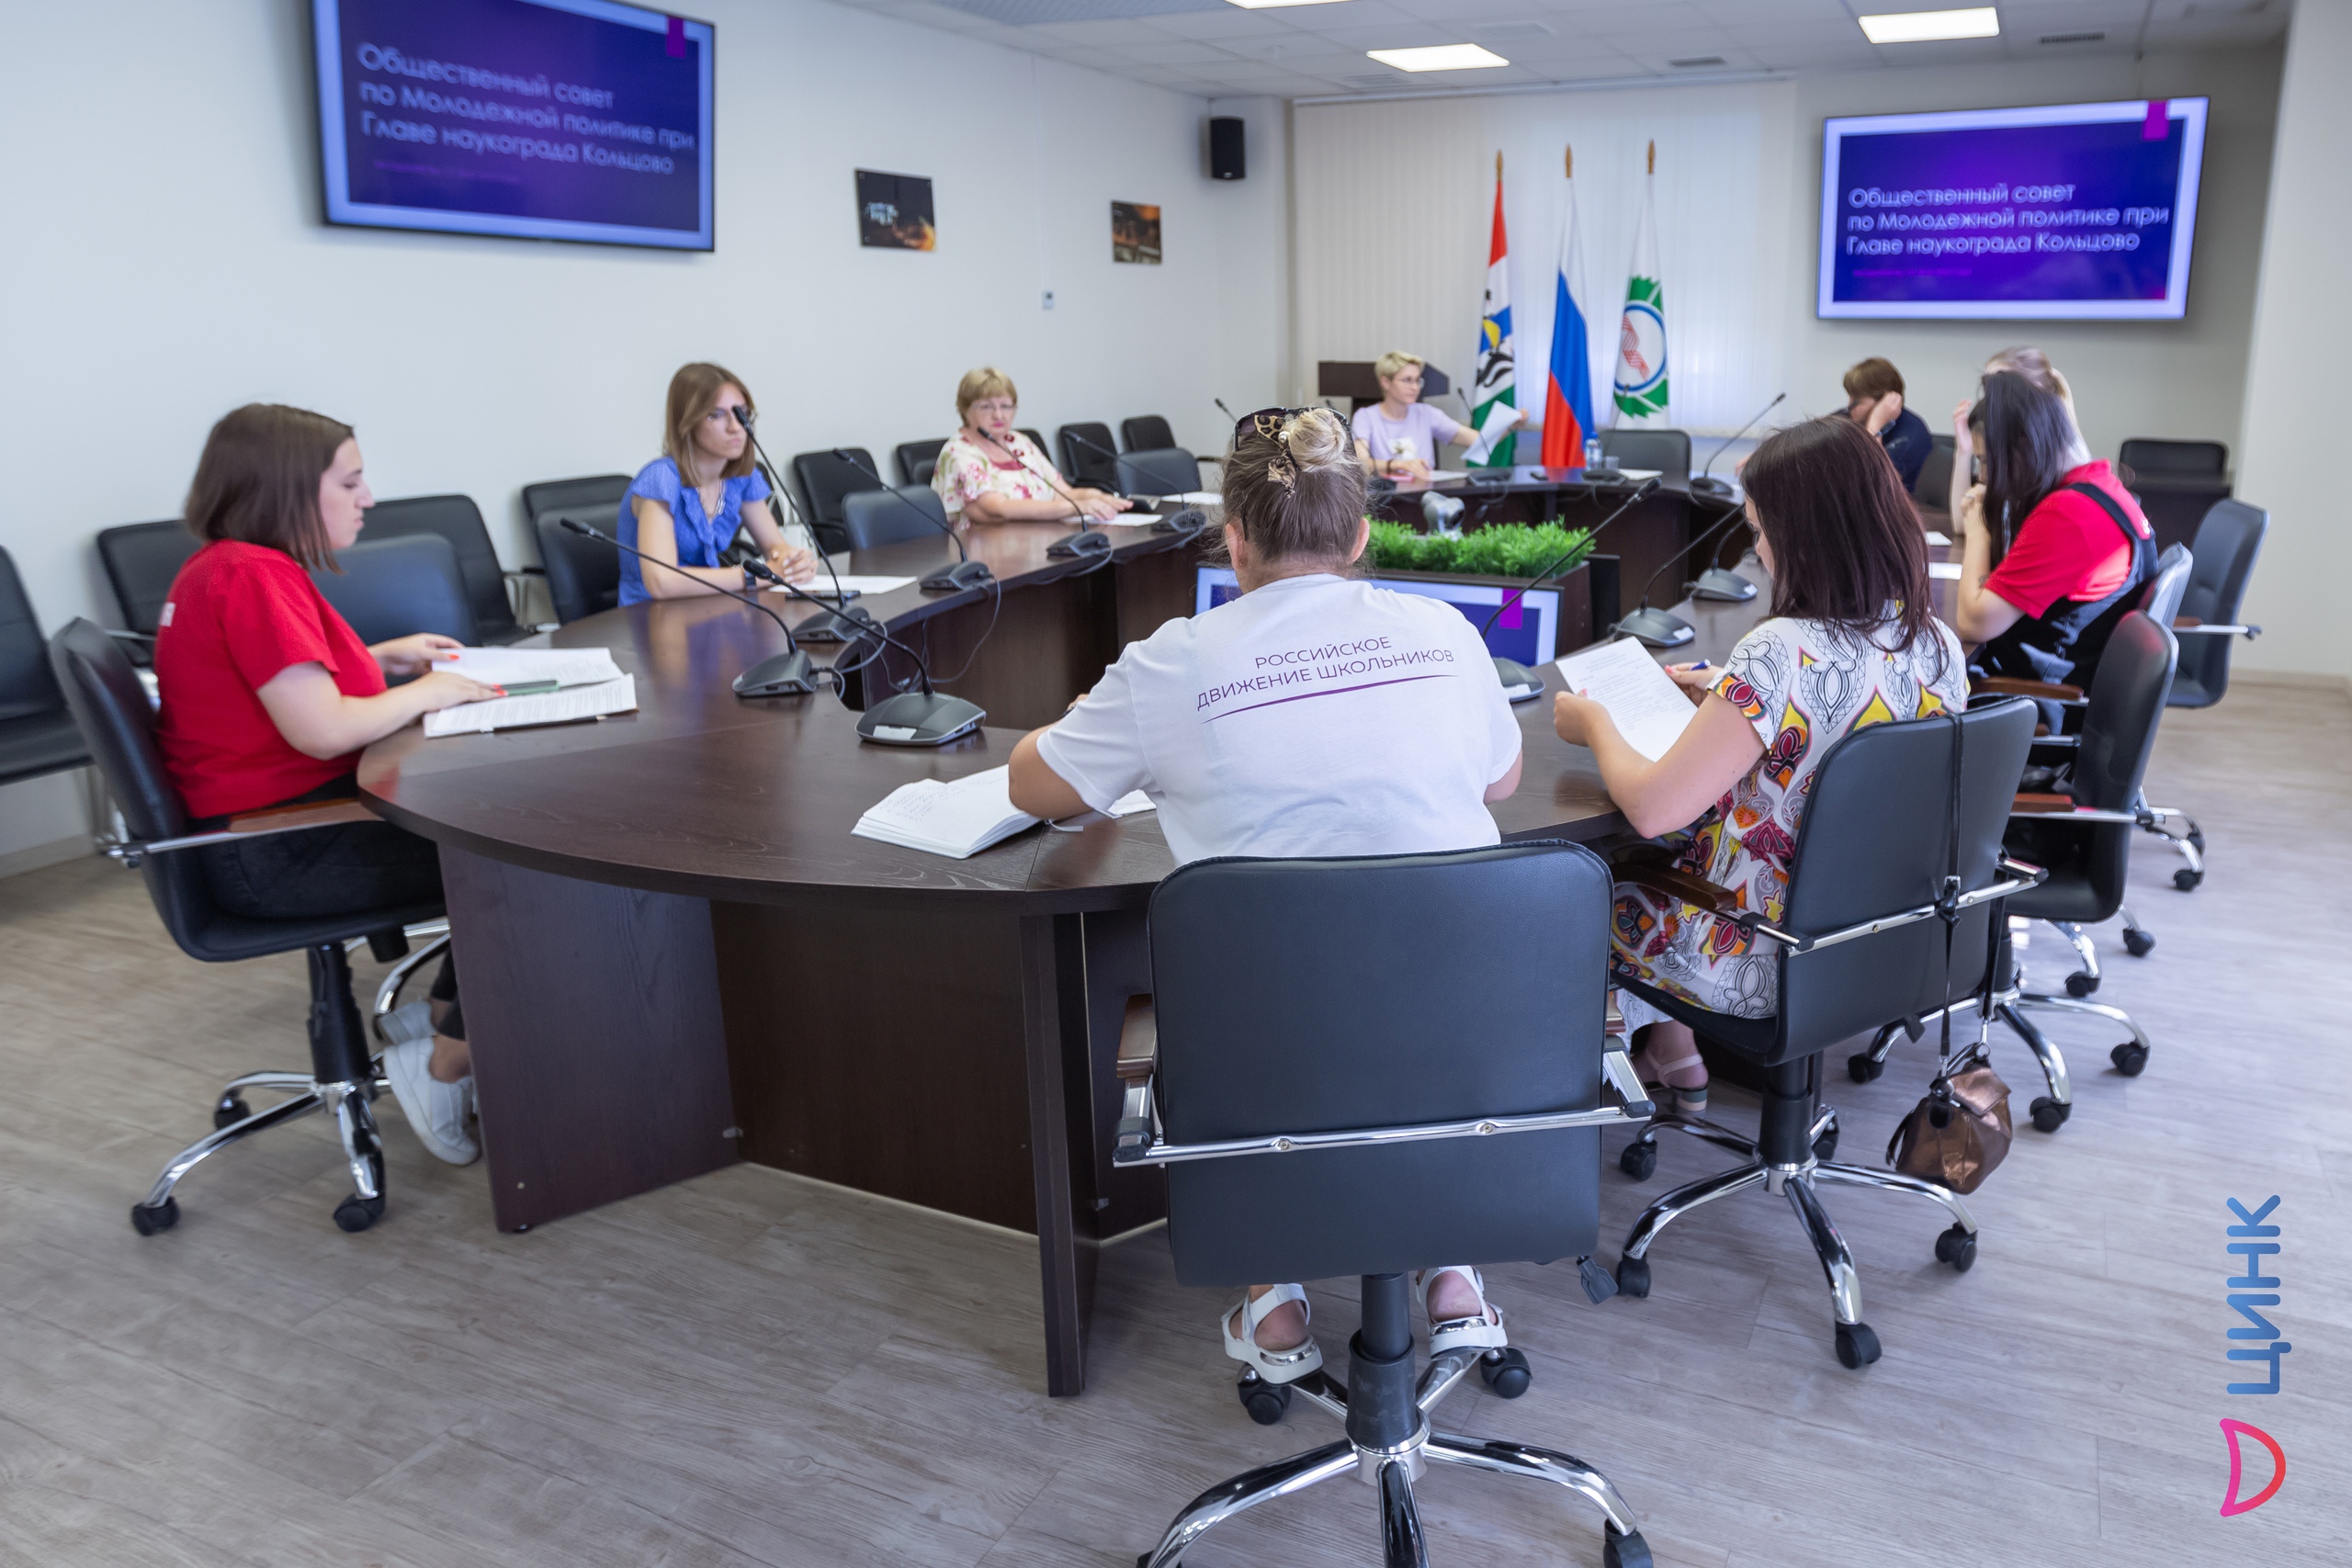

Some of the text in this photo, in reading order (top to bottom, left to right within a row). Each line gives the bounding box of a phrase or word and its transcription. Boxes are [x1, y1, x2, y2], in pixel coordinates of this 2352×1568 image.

[357, 42, 614, 109] Общественный совет
[359, 81, 695, 152] по Молодежной политике при
[360, 109, 675, 175] Главе наукограда Кольцово
[1847, 206, 2169, 231] по Молодежной политике при
[1848, 183, 2075, 209] Общественный совет
[1846, 231, 2141, 258] Главе наукограда Кольцово
[1254, 636, 1392, 670] РОССИЙСКОЕ
[1196, 649, 1454, 712] ДВИЖЕНИЕ ШКОЛЬНИКОВ
